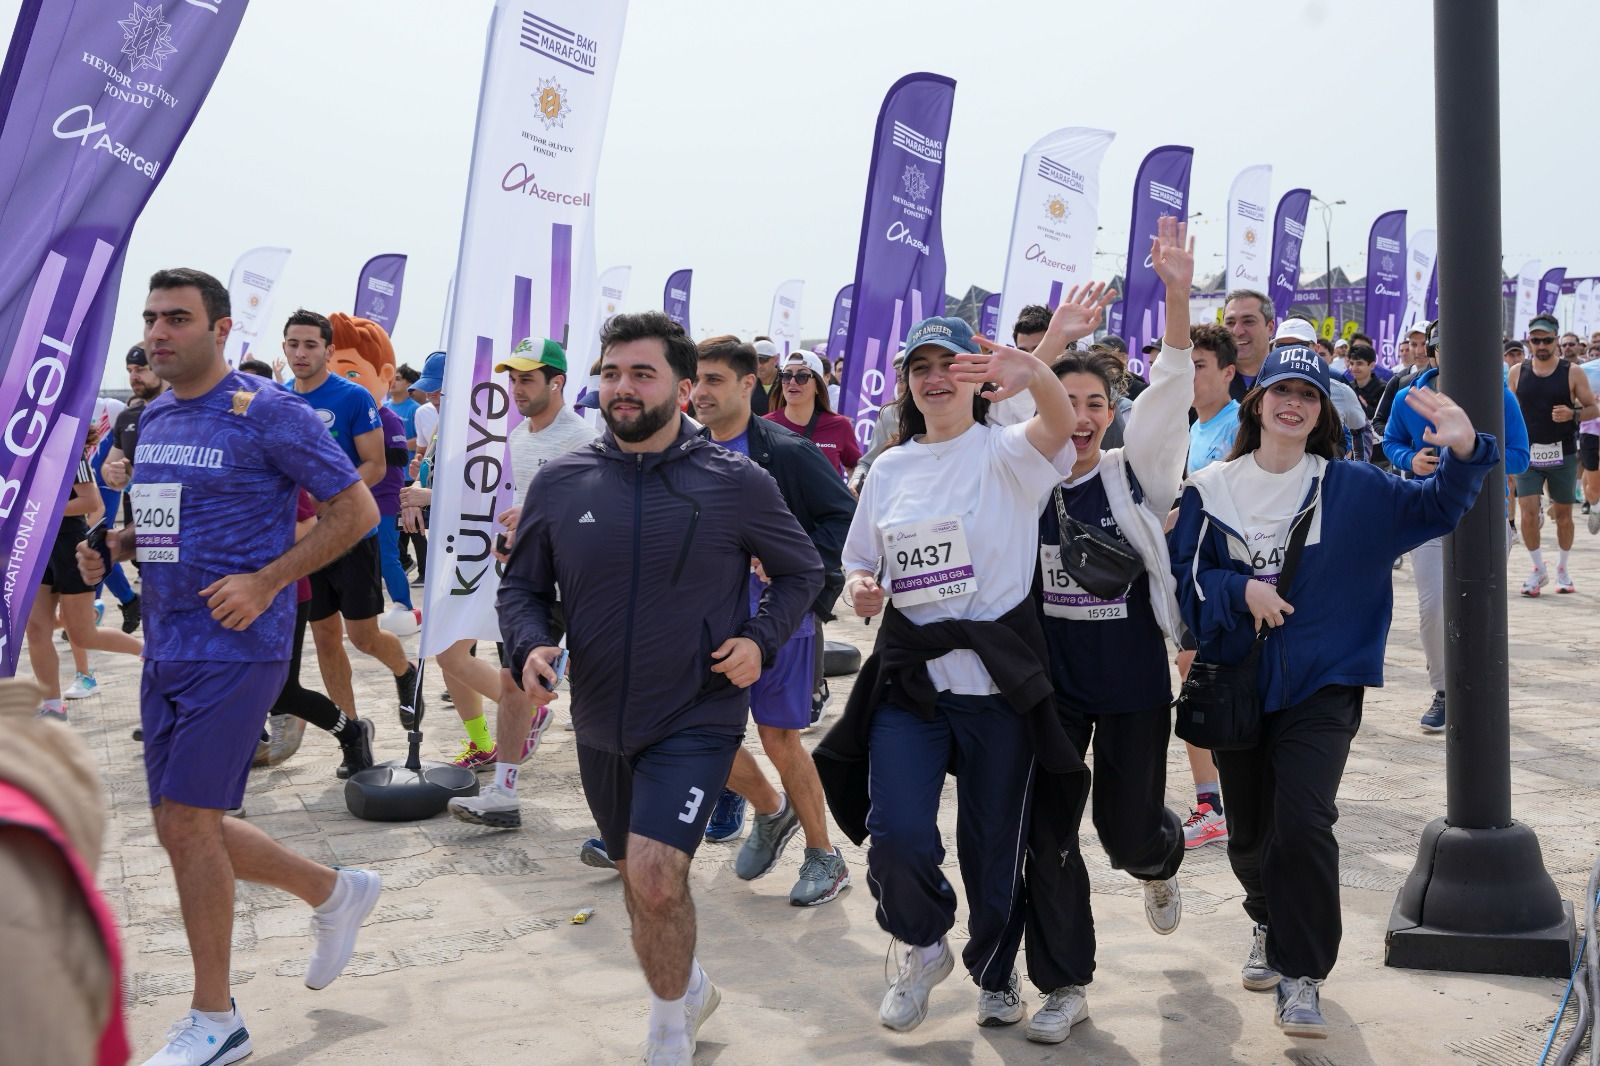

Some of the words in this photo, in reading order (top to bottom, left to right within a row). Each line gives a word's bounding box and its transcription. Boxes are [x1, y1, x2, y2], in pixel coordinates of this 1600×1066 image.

[540, 35, 597, 68] MARAFONU
[576, 34, 597, 54] BAKI
[81, 51, 132, 89] HEYDƏR
[136, 80, 179, 109] ƏLİYEV
[104, 82, 154, 109] FONDU
[533, 145, 557, 159] FONDU
[905, 138, 943, 160] MARAFONU
[925, 137, 943, 150] BAKI
[93, 133, 161, 181] Azercell
[529, 183, 591, 207] Azercell
[922, 325, 953, 338] ANGELES
[1280, 347, 1321, 374] UCLA
[1533, 450, 1560, 460] 12028
[445, 381, 511, 596] KÜLƏYƏ
[135, 507, 175, 528] 2406
[3, 498, 41, 608] ARATHON.AZ
[147, 550, 175, 561] 22406
[896, 541, 952, 572] 9437
[923, 571, 949, 584] QALİB
[949, 569, 968, 579] GƏL
[938, 582, 967, 598] 9437
[1087, 607, 1121, 619] 15932
[678, 786, 705, 824] 3
